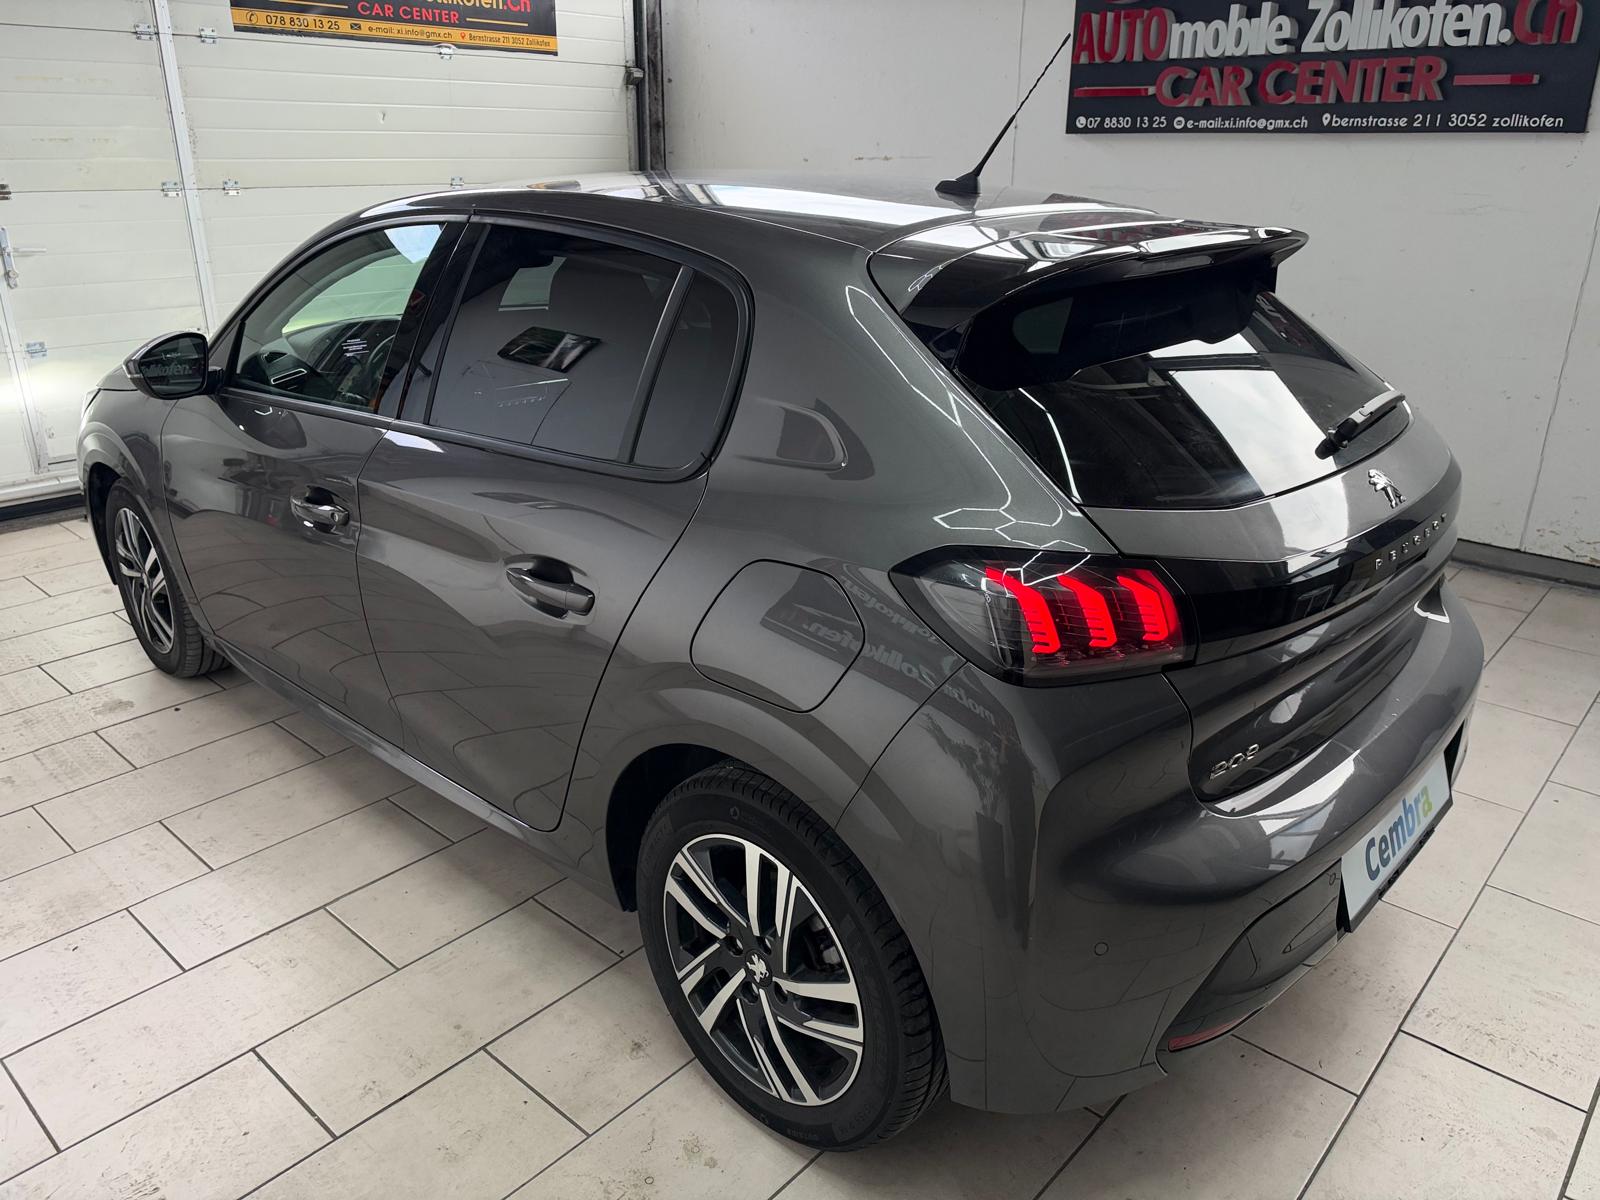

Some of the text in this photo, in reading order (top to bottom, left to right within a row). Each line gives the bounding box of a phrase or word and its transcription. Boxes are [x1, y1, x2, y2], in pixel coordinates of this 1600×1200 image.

[266, 14, 286, 26] 078
[289, 17, 309, 28] 830
[313, 18, 324, 30] 13
[328, 20, 340, 30] 25
[468, 33, 500, 44] Bernstrasse
[511, 37, 524, 45] 3052
[526, 38, 550, 47] Zollikofen
[357, 2, 459, 24] CAR CENTER
[1072, 2, 1298, 64] AUTOmobile
[1155, 55, 1447, 107] CAR CENTER
[1087, 118, 1100, 129] 07
[1104, 117, 1132, 129] 8830
[1136, 116, 1149, 129] 13
[1153, 116, 1167, 128] 25
[1331, 114, 1408, 128] bernstrasse
[1413, 114, 1442, 127] 211
[1448, 113, 1487, 127] 3052
[1492, 113, 1564, 128] zollikofen
[1375, 513, 1447, 570] PEUGEOT
[1209, 743, 1259, 780] 208
[1365, 785, 1433, 881] Cembra
